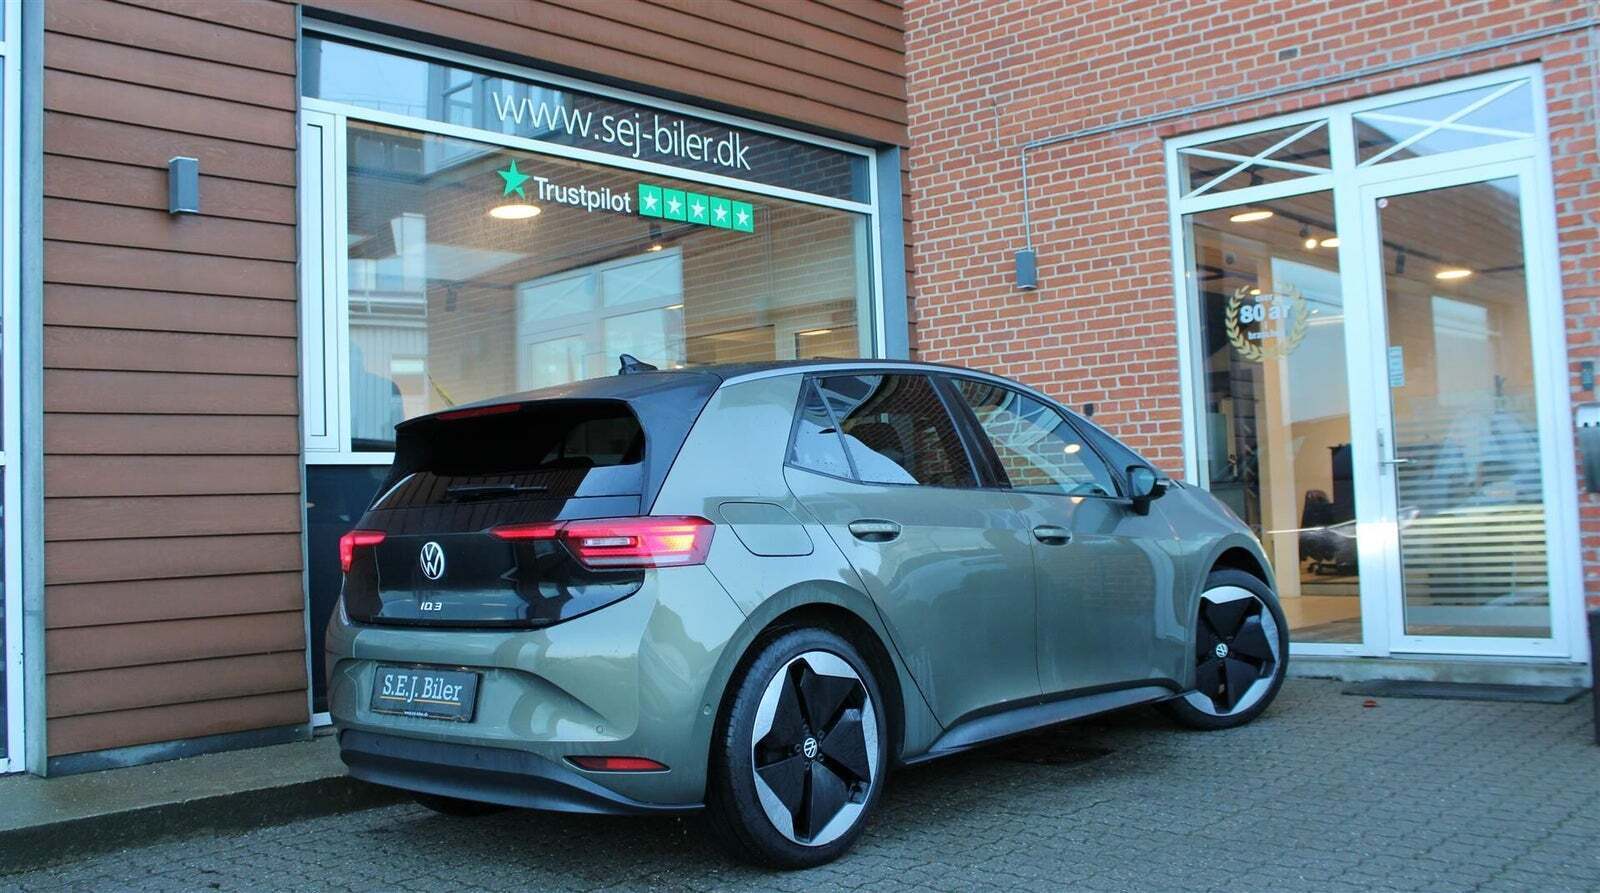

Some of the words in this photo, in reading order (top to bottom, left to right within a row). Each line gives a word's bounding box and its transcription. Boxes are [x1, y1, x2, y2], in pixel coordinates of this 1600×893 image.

[493, 91, 751, 170] www.sej-biler.dk
[533, 176, 631, 214] Trustpilot
[1239, 303, 1265, 323] 80
[382, 674, 418, 702] S.E.J.
[421, 676, 462, 701] Biler
